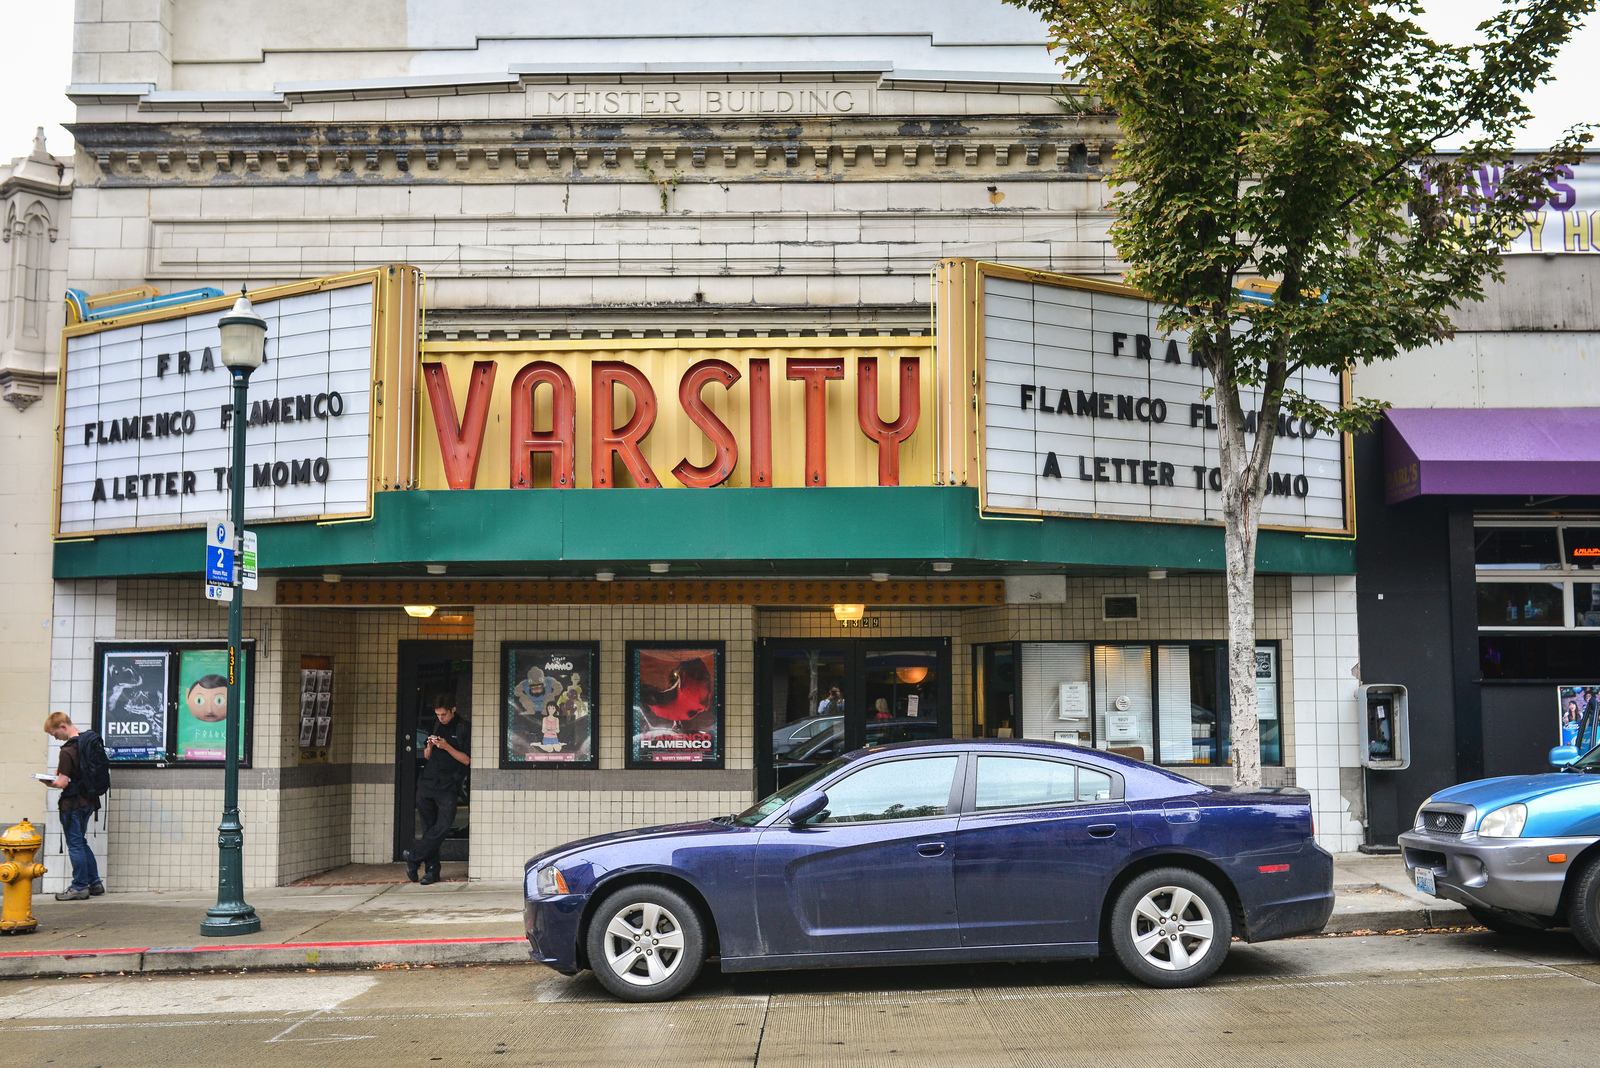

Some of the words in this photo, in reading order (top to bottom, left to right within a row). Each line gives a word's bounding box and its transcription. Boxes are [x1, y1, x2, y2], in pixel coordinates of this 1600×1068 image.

[547, 91, 684, 114] MEISTER
[705, 90, 855, 114] BUILDING
[85, 410, 196, 447] FLAMENCO
[220, 391, 343, 430] FAMENCO
[422, 357, 921, 489] VARSITY
[1021, 384, 1167, 423] FLAMENCO
[1191, 403, 1317, 439] FLMNCO
[92, 478, 106, 503] A
[113, 470, 196, 500] LETTER
[253, 457, 329, 489] MOMO
[1043, 452, 1062, 478] A
[1078, 455, 1175, 487] LETTER
[216, 548, 224, 568] 2
[108, 721, 150, 735] FIXED
[640, 740, 712, 749] FLAMENCO
